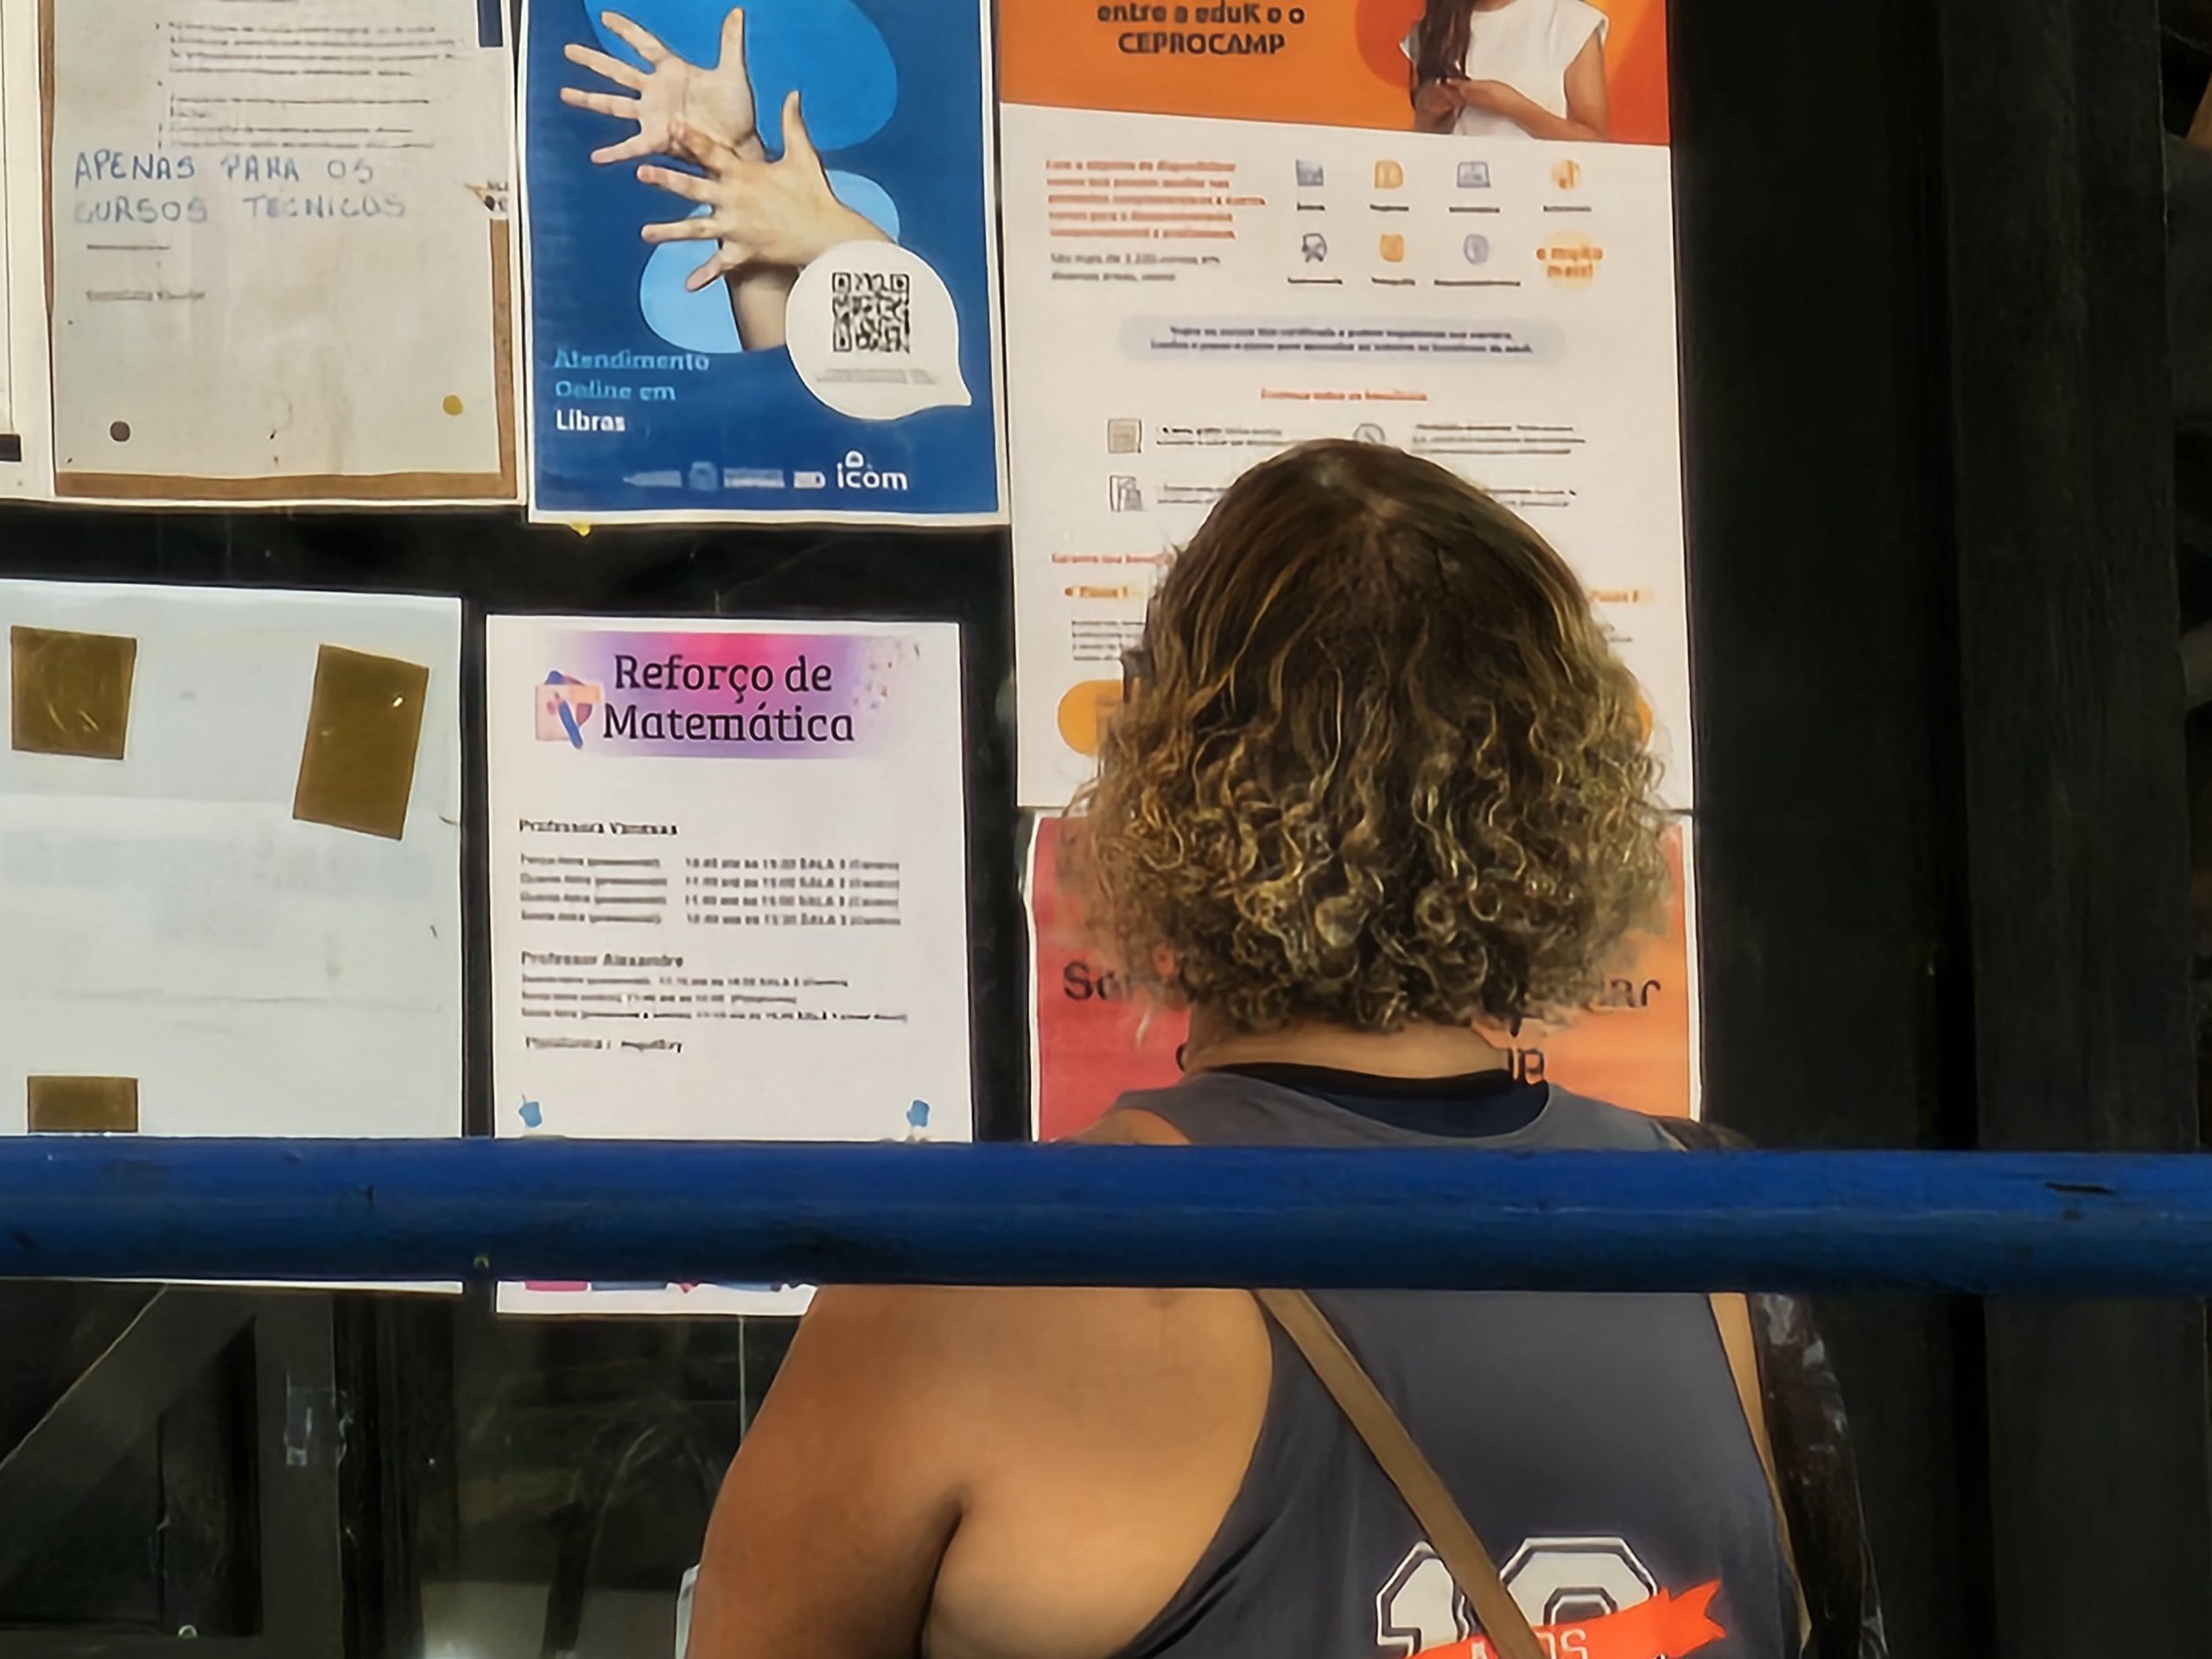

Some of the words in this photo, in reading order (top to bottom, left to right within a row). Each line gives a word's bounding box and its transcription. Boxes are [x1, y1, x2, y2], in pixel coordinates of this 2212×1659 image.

[1288, 7, 1306, 24] o
[1117, 31, 1286, 54] CEPROCAMP
[74, 149, 196, 187] APENAS
[219, 154, 300, 182] PARA
[326, 159, 374, 183] OS
[73, 194, 208, 225] CURSOS
[554, 348, 710, 371] Atendimento
[555, 380, 632, 400] Online
[639, 386, 677, 401] em
[556, 409, 626, 432] Libras
[836, 461, 908, 491] icom
[614, 654, 774, 704] Reforço
[785, 654, 833, 692] de
[603, 701, 855, 742] Matemática
